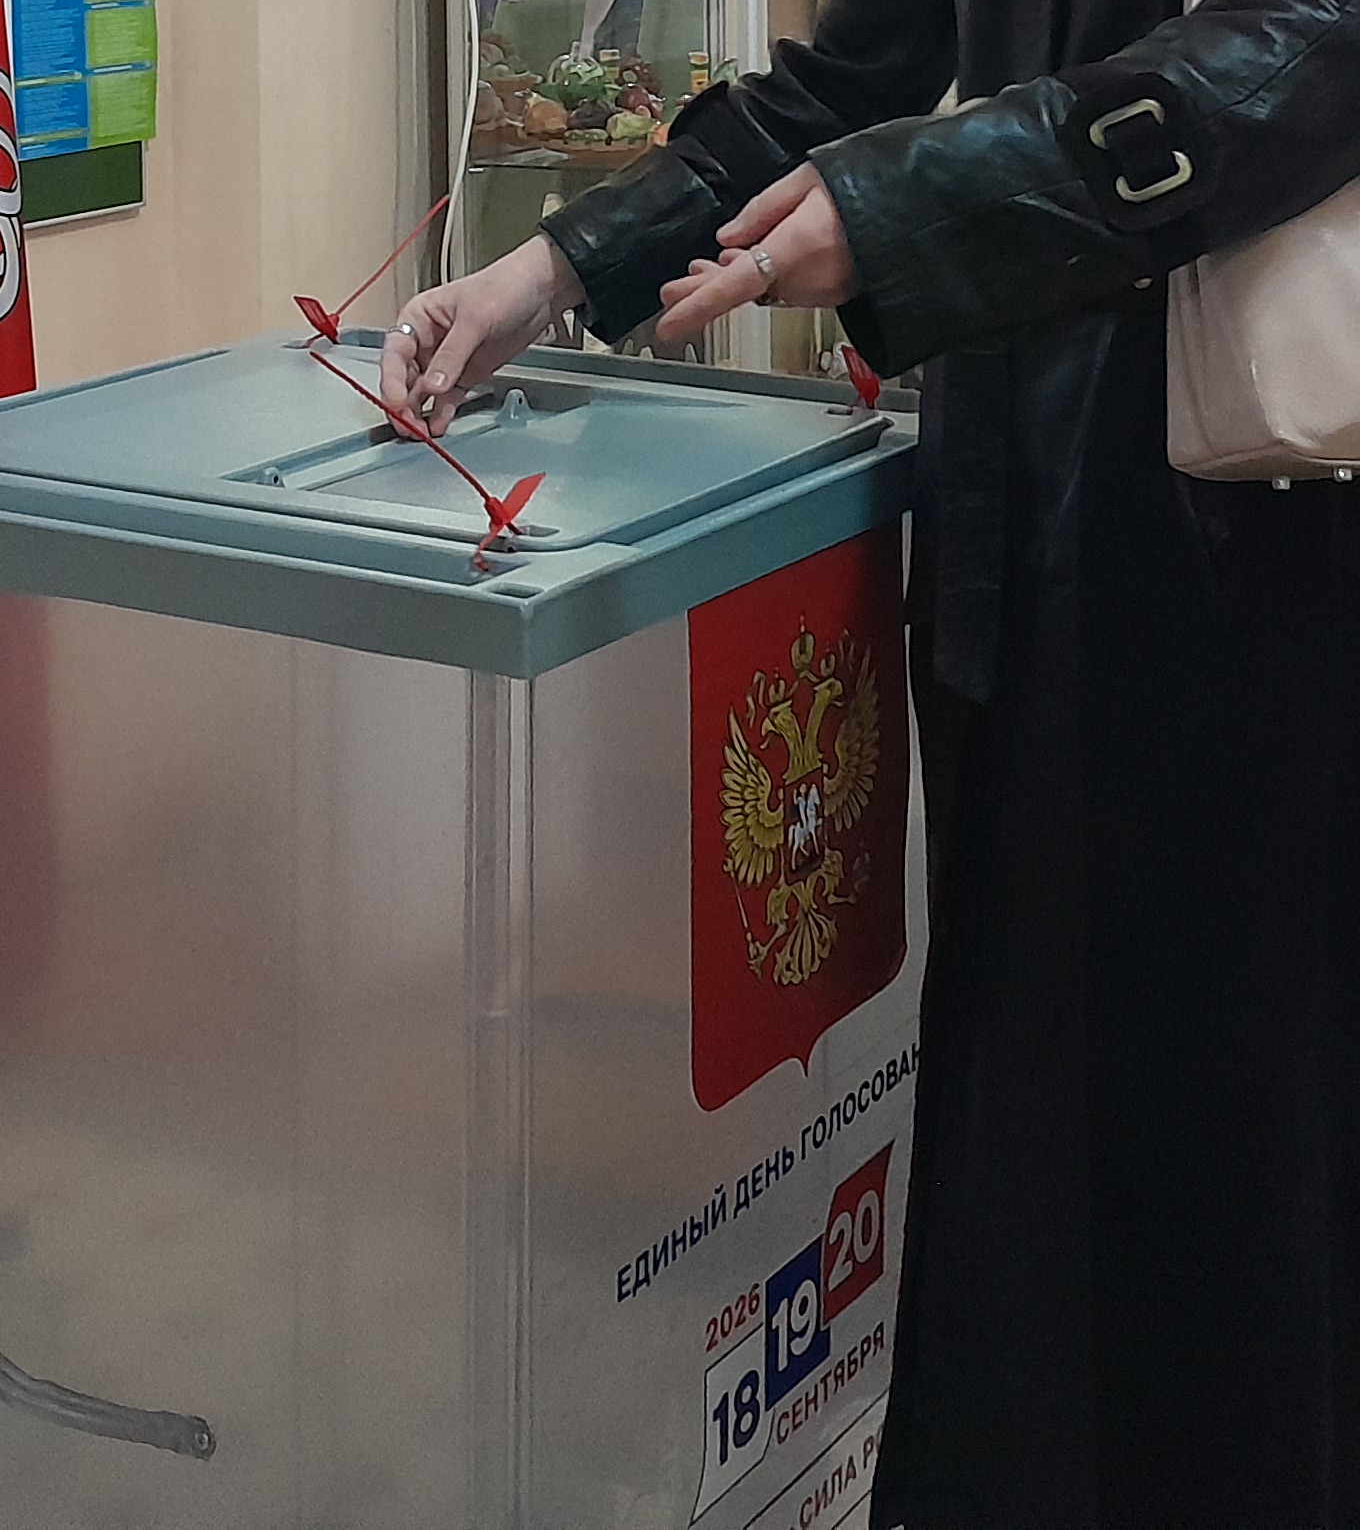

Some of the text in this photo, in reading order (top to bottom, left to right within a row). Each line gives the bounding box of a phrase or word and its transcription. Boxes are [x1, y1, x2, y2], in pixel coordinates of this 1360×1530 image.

[616, 1183, 727, 1304] ЕДИНЫЙ
[733, 1145, 795, 1220] ДЕНЬ
[705, 1282, 761, 1352] 2026
[712, 1189, 881, 1466] 18 19 20
[775, 1321, 885, 1446] СЕНТЯБРЯ
[799, 1454, 857, 1529] СИЛА
